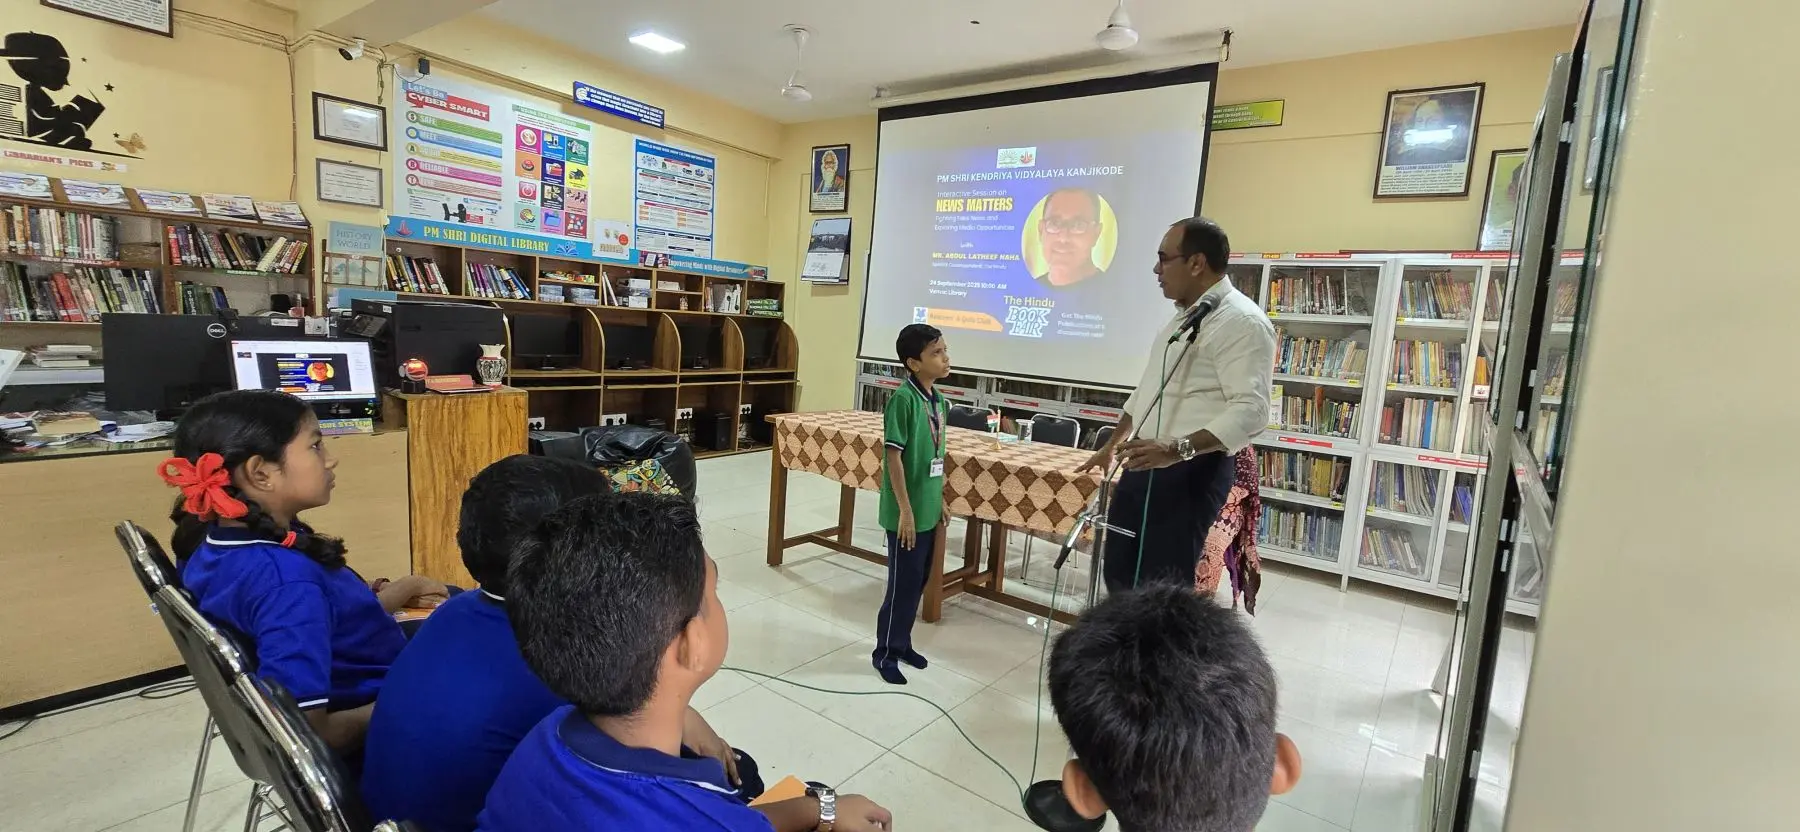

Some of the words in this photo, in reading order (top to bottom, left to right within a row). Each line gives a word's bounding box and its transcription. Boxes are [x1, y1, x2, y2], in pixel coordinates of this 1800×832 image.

[408, 82, 430, 95] Let's
[408, 92, 447, 107] CYBER
[449, 103, 488, 118] SMART
[69, 158, 93, 168] PICKS
[951, 174, 969, 182] SHRI
[971, 171, 1012, 181] KENDRIYA
[1015, 169, 1064, 180] VIDYALAYA
[1067, 166, 1124, 177] KANJIKODE
[936, 199, 964, 212] NEWS
[966, 197, 1013, 212] MATTERS
[336, 230, 372, 241] HISTORY
[424, 226, 439, 238] PM
[443, 229, 467, 242] SHRI
[470, 232, 507, 247] DIGITAL
[511, 237, 550, 252] LIBRARY
[338, 239, 371, 250] WORLD
[1004, 295, 1022, 306] The
[1024, 297, 1055, 308] Hindu
[1006, 306, 1050, 324] BOOK
[1010, 321, 1043, 336] FAIR
